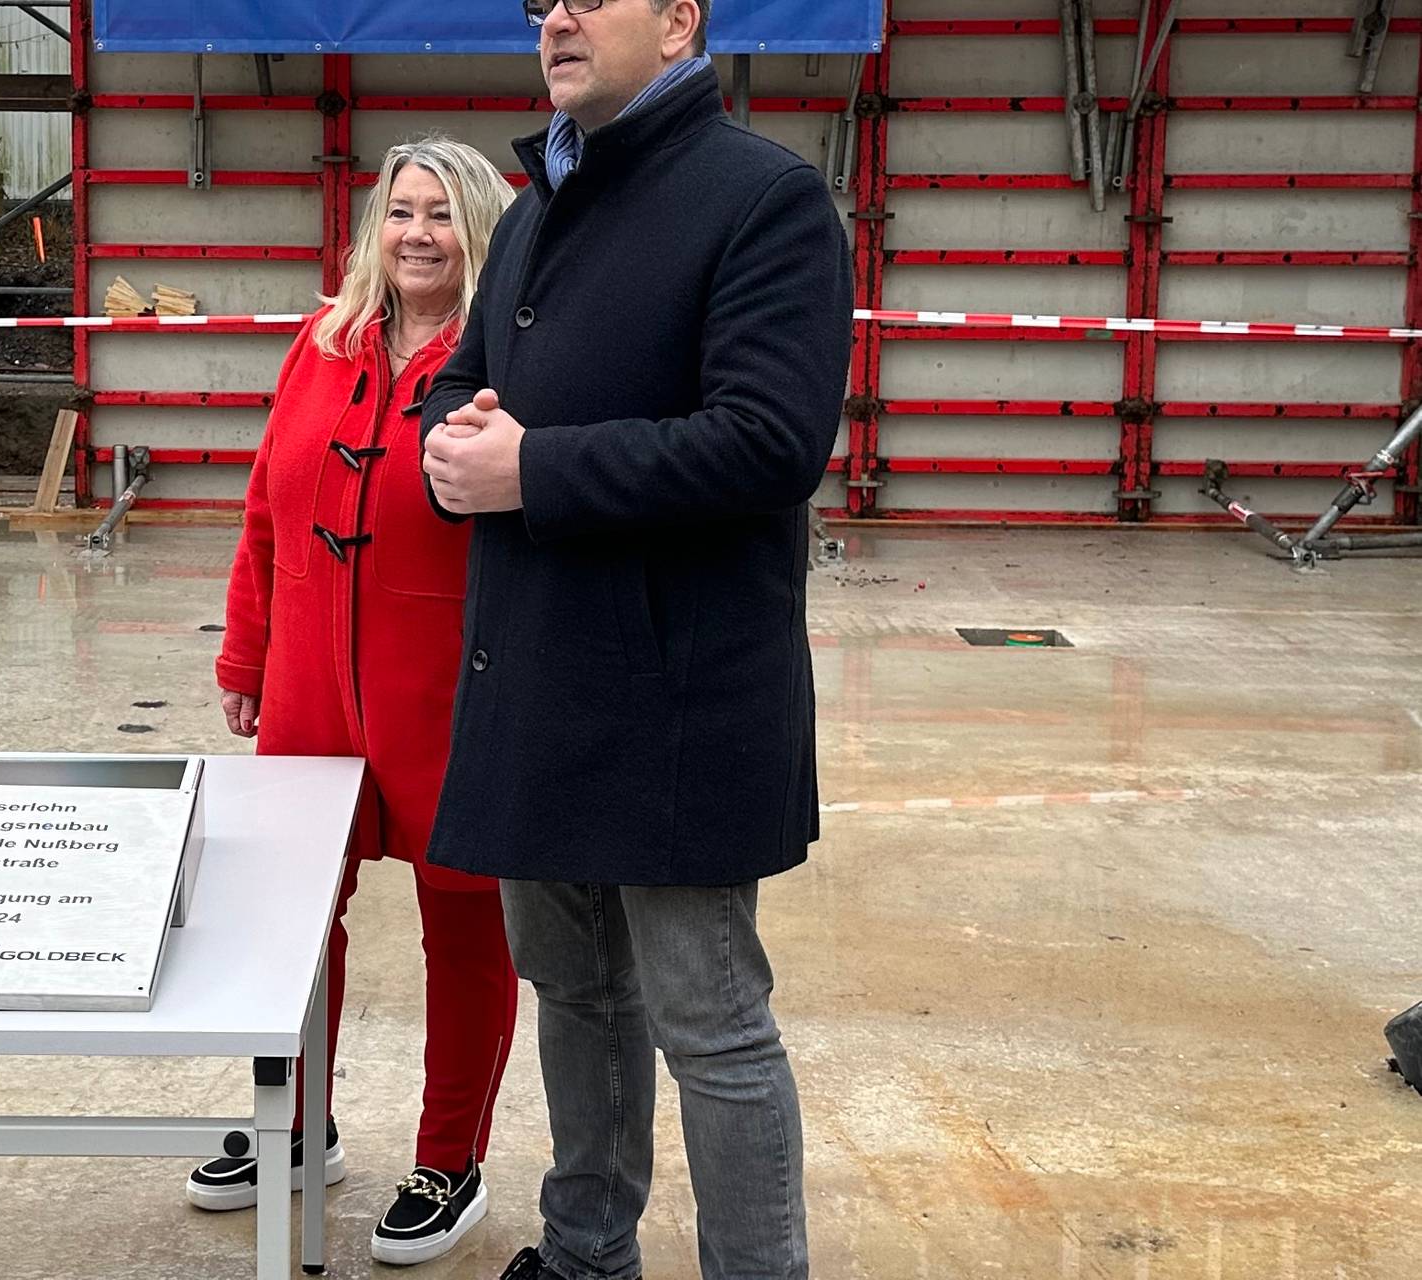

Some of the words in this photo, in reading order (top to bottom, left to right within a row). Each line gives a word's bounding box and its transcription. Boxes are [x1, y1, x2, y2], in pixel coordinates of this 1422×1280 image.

[23, 839, 120, 853] Nußberg
[58, 894, 94, 904] am
[0, 951, 127, 962] GOLDBECK
